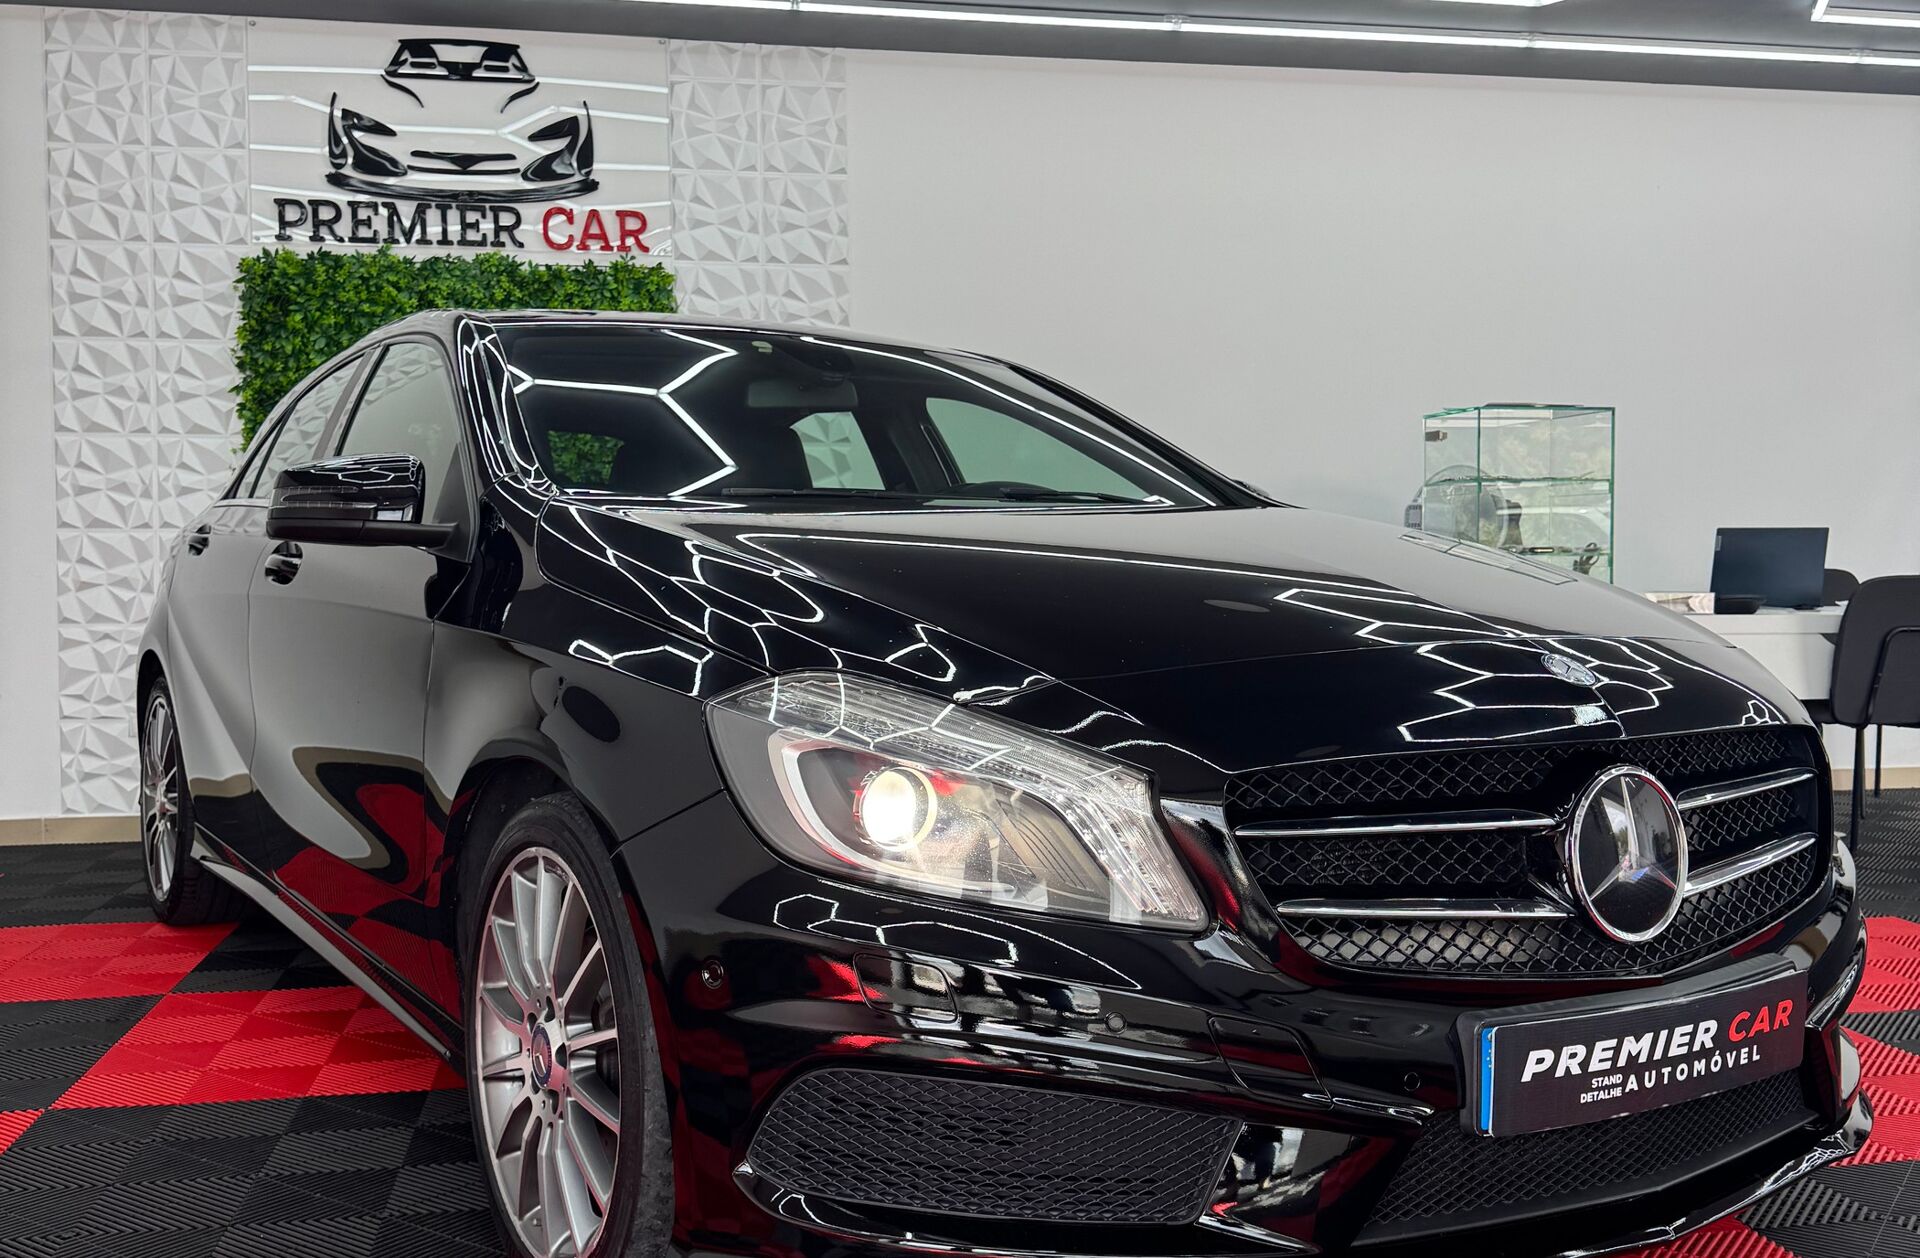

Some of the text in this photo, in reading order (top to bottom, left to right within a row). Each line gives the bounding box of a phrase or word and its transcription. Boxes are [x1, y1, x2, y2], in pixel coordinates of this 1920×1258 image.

[273, 198, 650, 253] PREMIER CAR
[1520, 999, 1794, 1082] PREMIER CAR
[1591, 1073, 1623, 1088] STAND
[1625, 1045, 1761, 1093] AUTOMÓVEL
[1580, 1087, 1622, 1104] DETALHE
